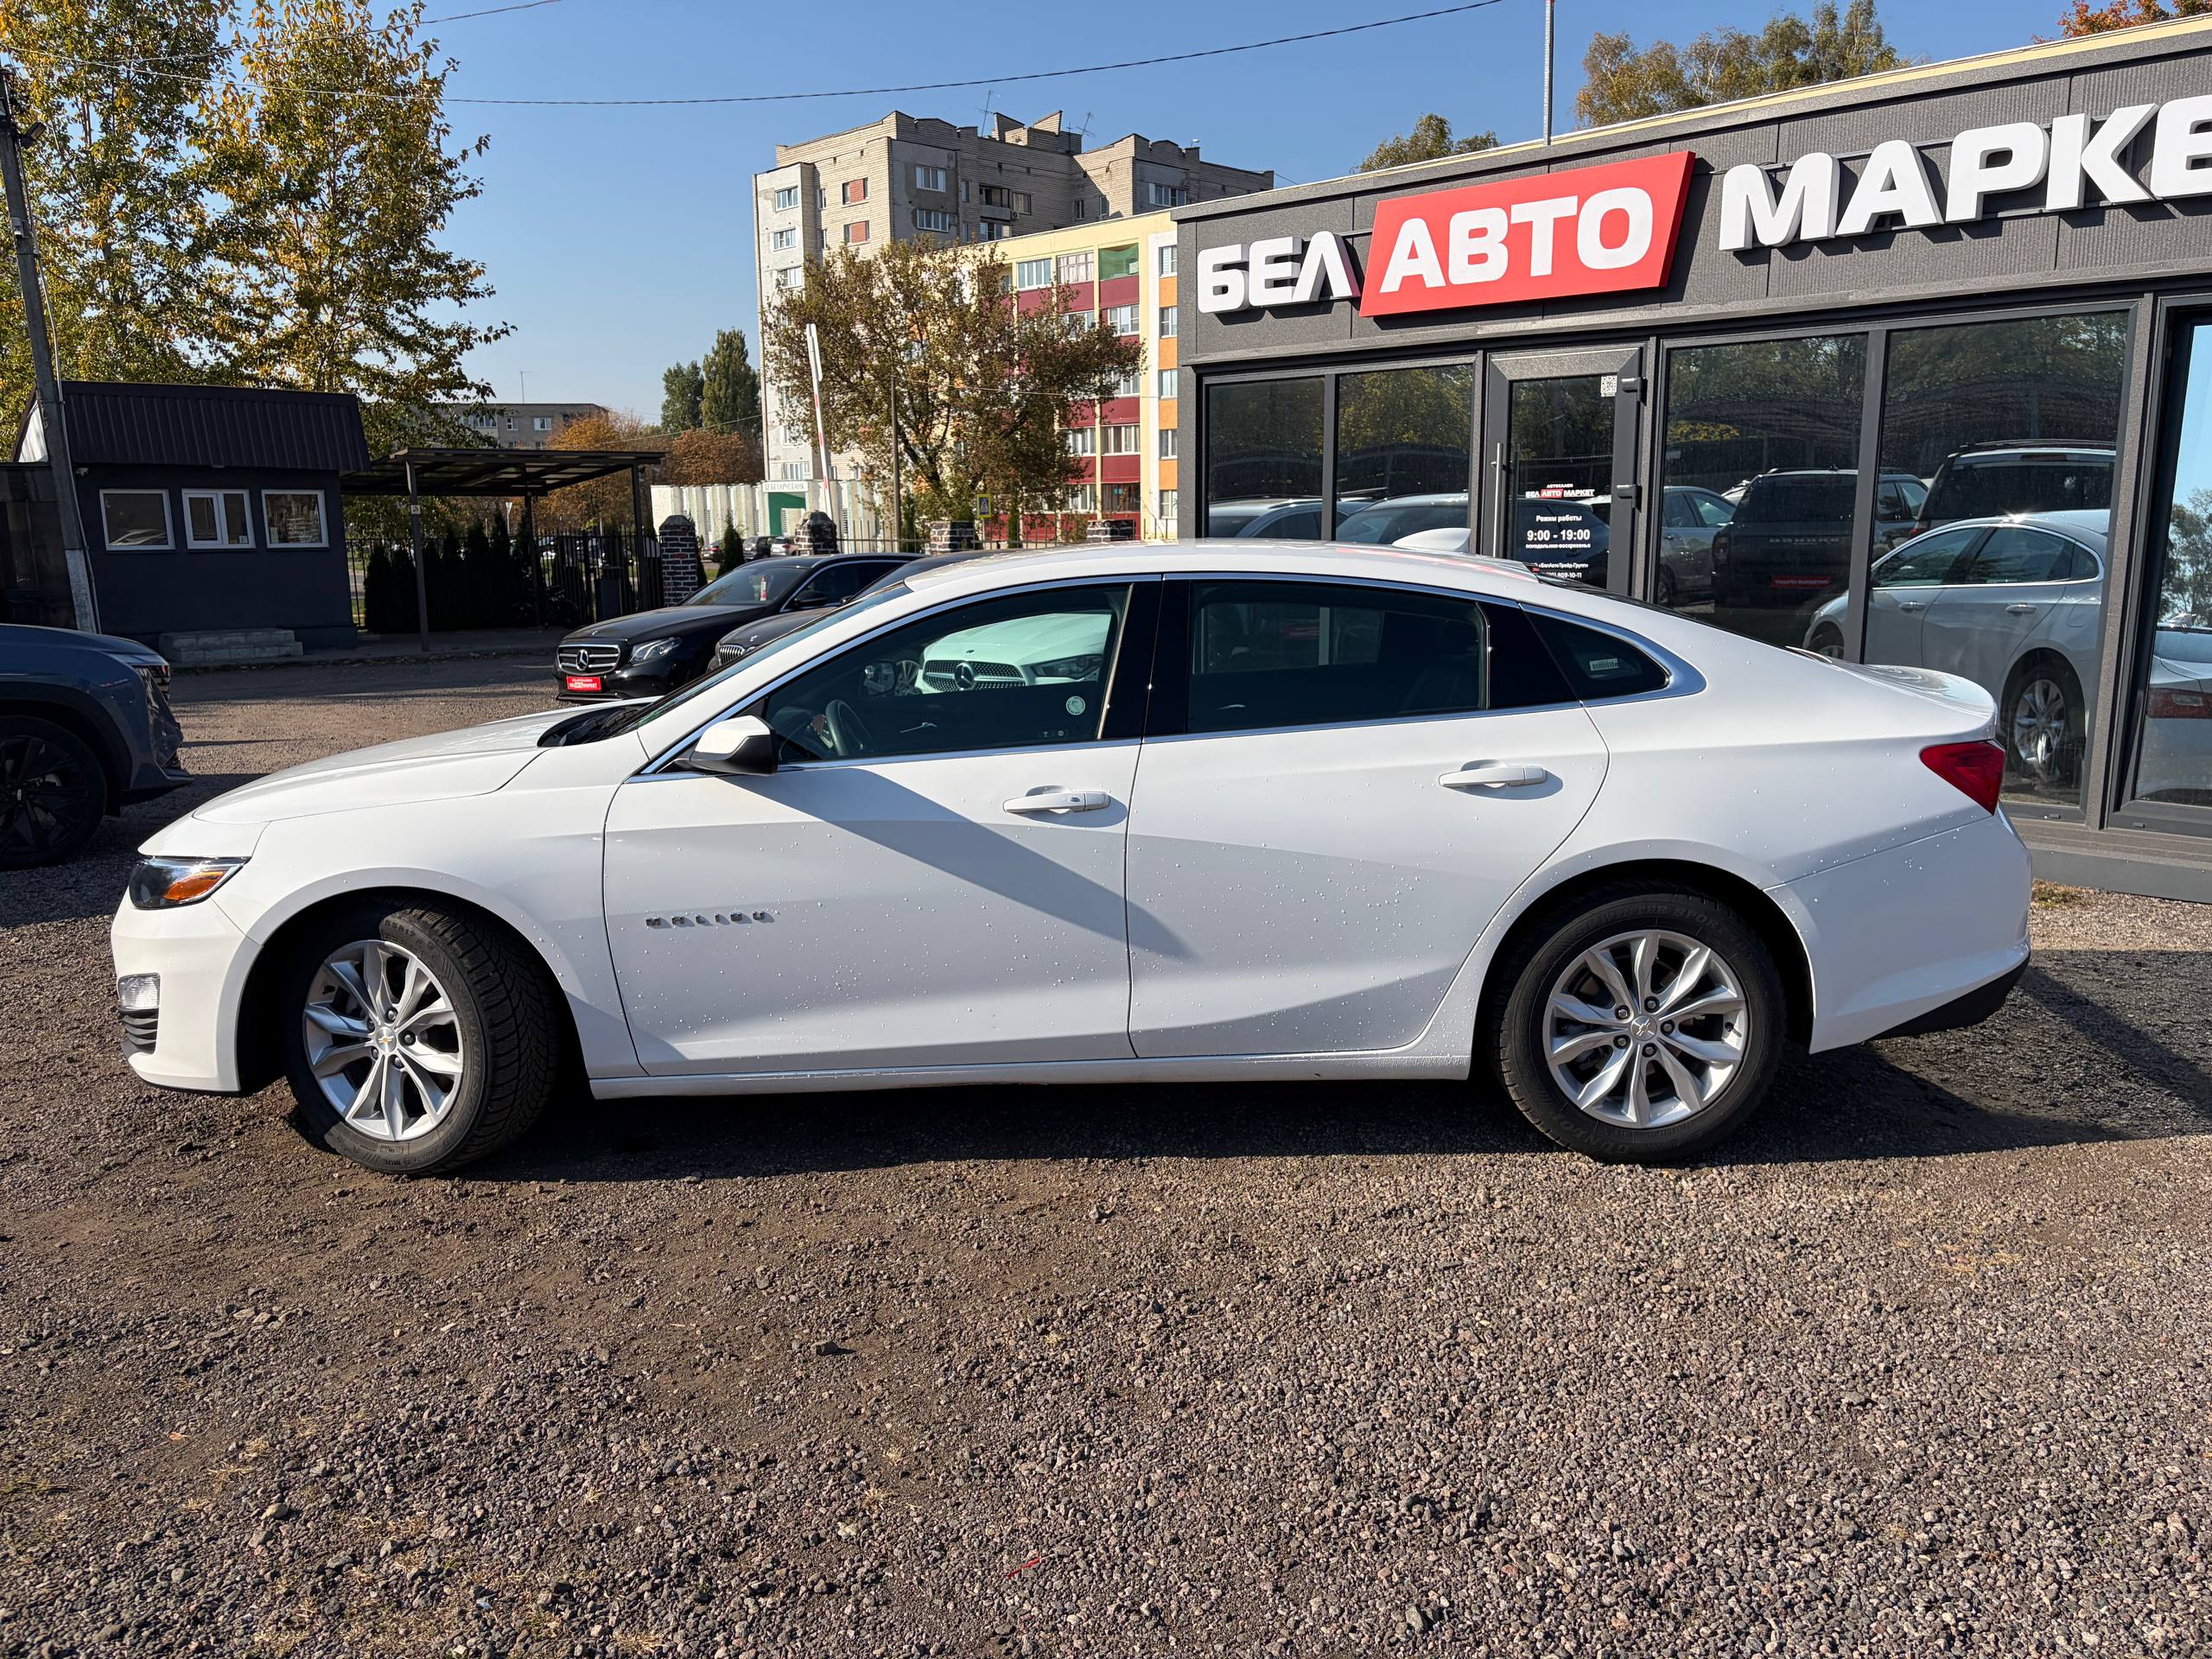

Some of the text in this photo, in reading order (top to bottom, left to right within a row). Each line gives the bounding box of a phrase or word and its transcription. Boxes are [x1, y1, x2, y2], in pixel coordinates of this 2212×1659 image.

[1198, 94, 2212, 314] БЕЛ АВТО МАРКЕ
[1563, 489, 1595, 498] МАРКЕТ
[1558, 514, 1582, 523] работы
[1527, 530, 1550, 541] 9:00
[1560, 529, 1591, 541] 19:00
[645, 911, 766, 927] MALIBU
